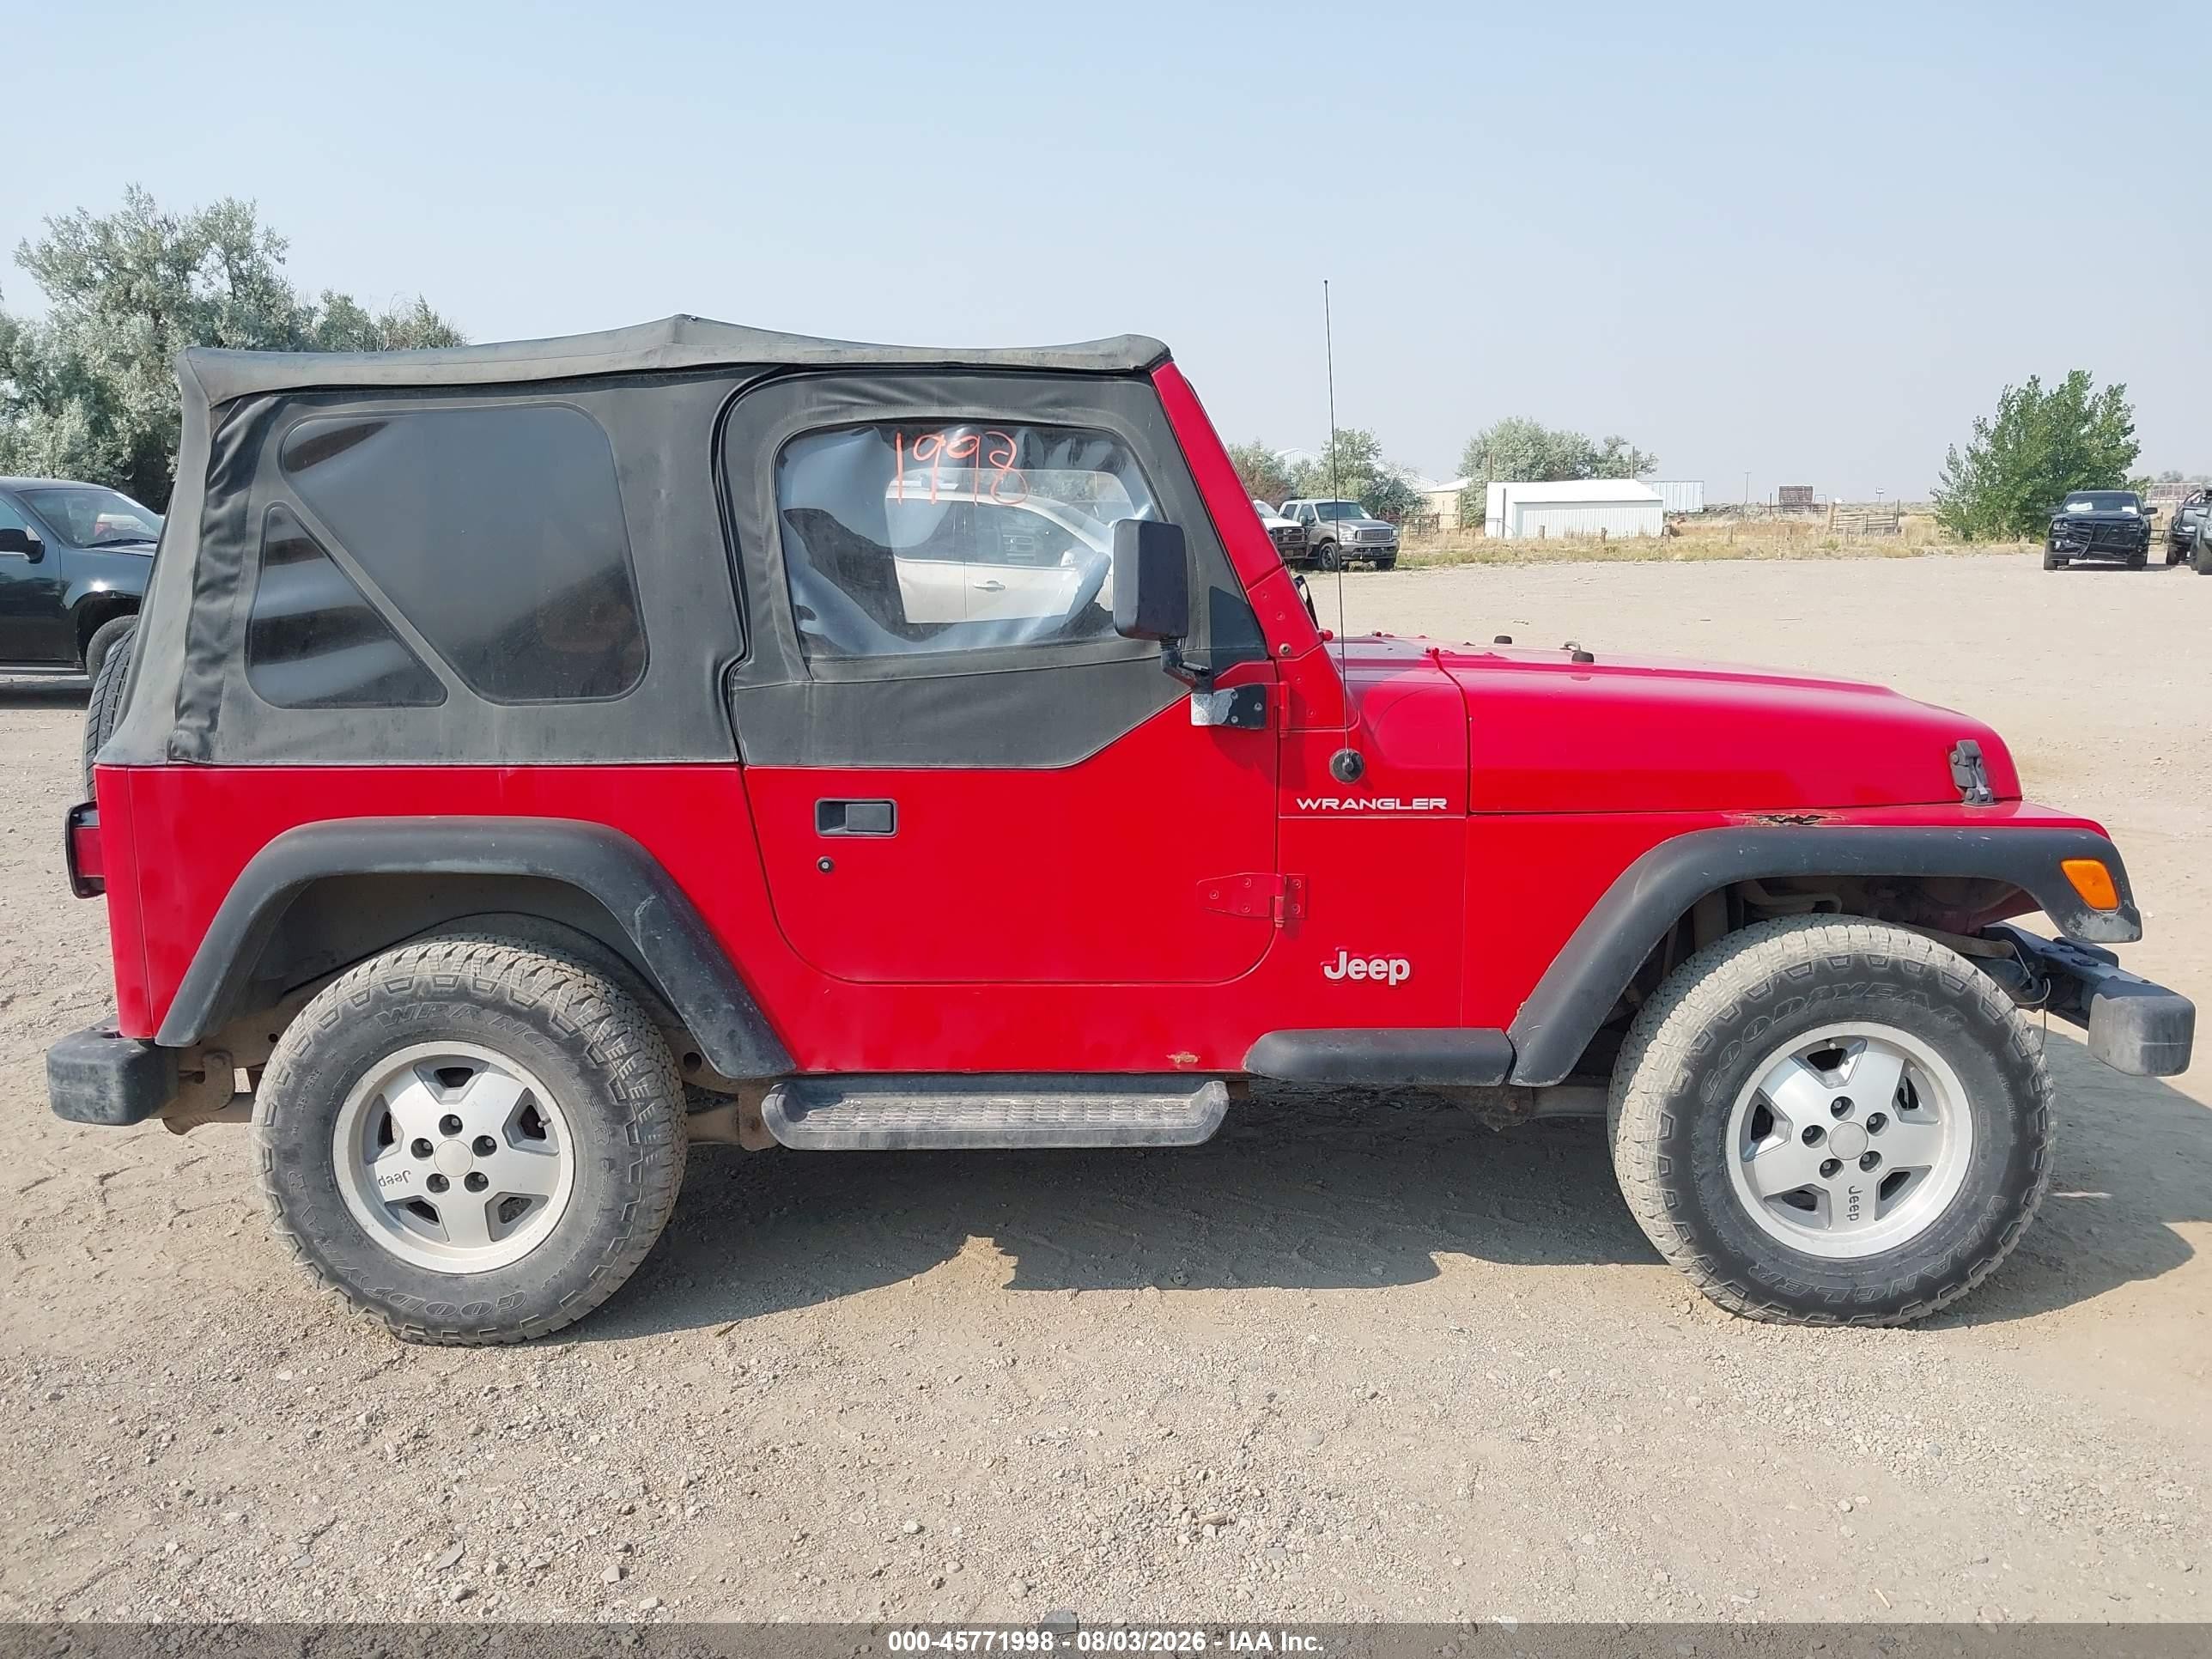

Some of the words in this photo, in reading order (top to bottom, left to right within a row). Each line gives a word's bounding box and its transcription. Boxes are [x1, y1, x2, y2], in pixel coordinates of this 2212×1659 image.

[896, 431, 1029, 507] 1998
[1297, 798, 1448, 810] WRANGLER
[1323, 951, 1411, 986] Jeep
[374, 1002, 612, 1146] WRANGLER
[1700, 982, 1968, 1103] GOODYEAR
[378, 1170, 411, 1188] Jeep
[1846, 1185, 1861, 1222] Jeep
[289, 1170, 527, 1318] GOODYEAR
[1747, 1195, 2007, 1304] WRANGLER
